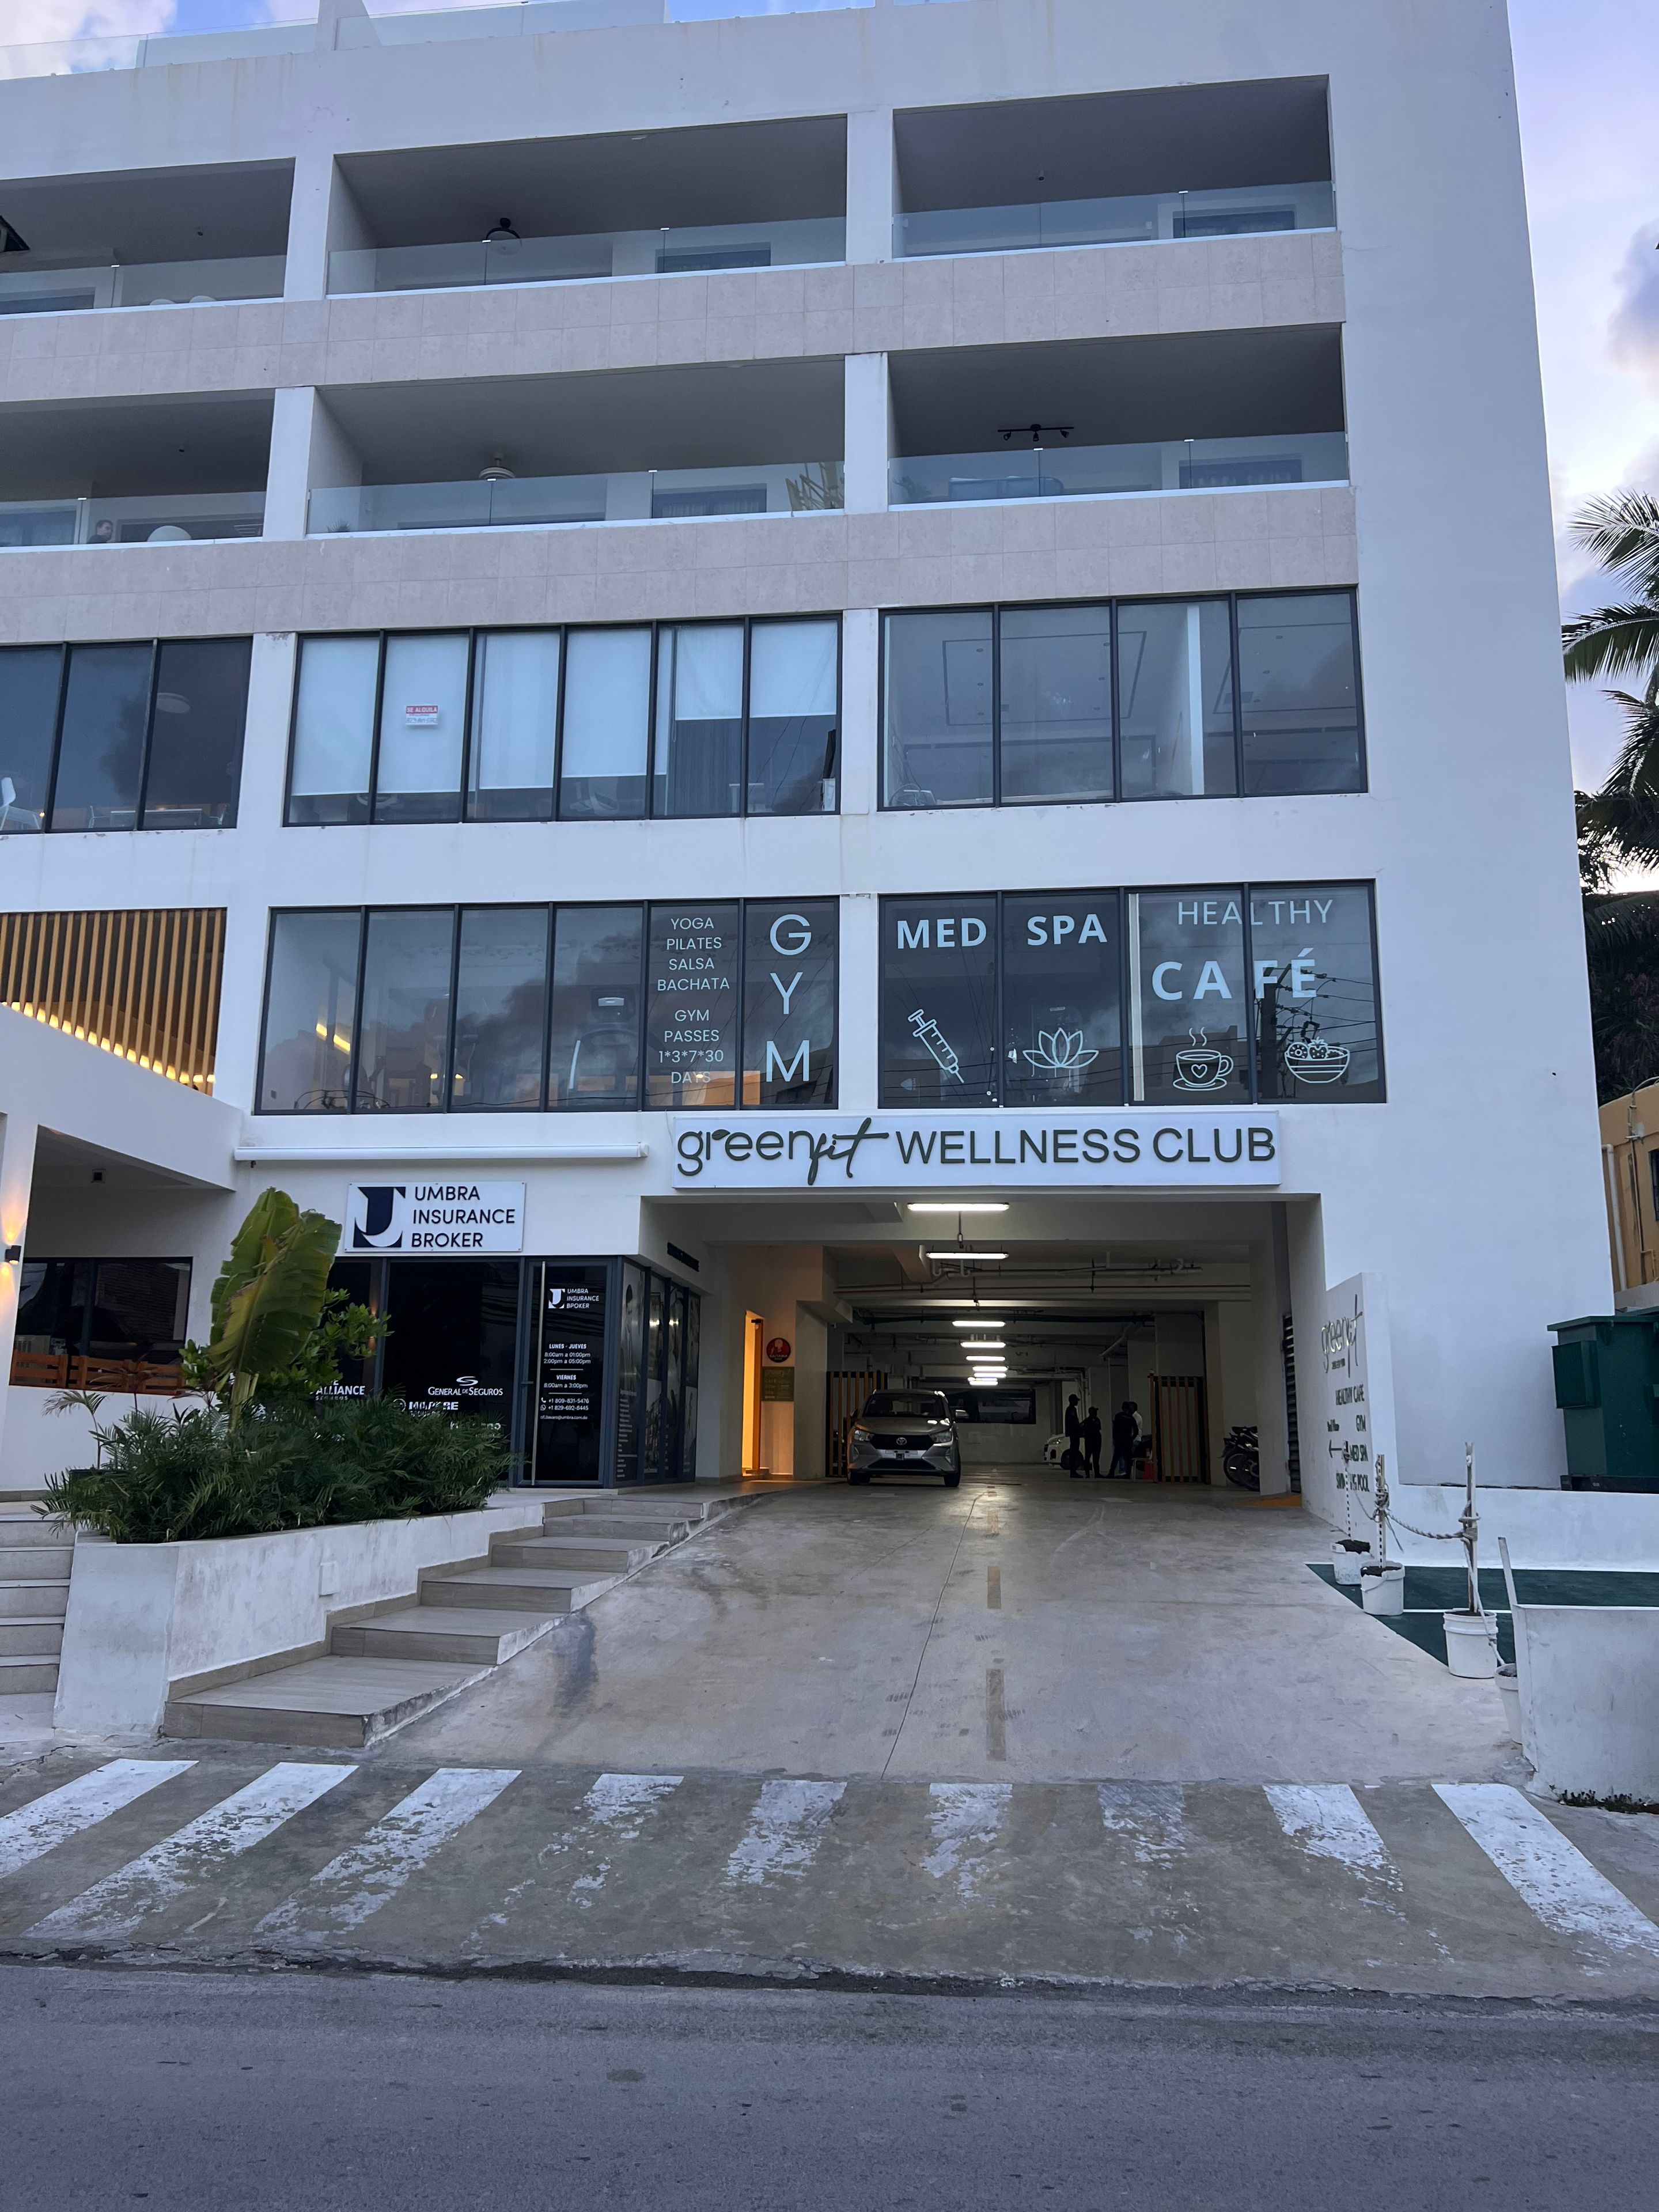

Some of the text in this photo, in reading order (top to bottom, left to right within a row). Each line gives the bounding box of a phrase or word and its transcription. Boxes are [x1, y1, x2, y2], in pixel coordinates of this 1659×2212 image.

[1178, 899, 1333, 925] HEALTHY
[671, 917, 714, 930] YOGA
[897, 914, 1107, 949] MED SPA
[666, 937, 722, 950] PILATES
[669, 957, 715, 970] SALSA
[1152, 948, 1317, 1001] CAFÉ
[657, 978, 730, 991] BACHATA
[675, 1009, 709, 1022] GYM
[664, 1029, 719, 1043] PASSES
[671, 1071, 711, 1084] DAYS
[895, 1128, 1141, 1164] WELLNESS
[1153, 1127, 1275, 1162] CLUB
[414, 1185, 480, 1200] UMBRA
[412, 1209, 516, 1224] INSURANCE
[411, 1232, 483, 1248] BROKER
[316, 1385, 366, 1395] ALLIANCE
[427, 1387, 461, 1395] GENERAL
[468, 1387, 503, 1396] SEGUROS
[1356, 1414, 1366, 1432] GYM
